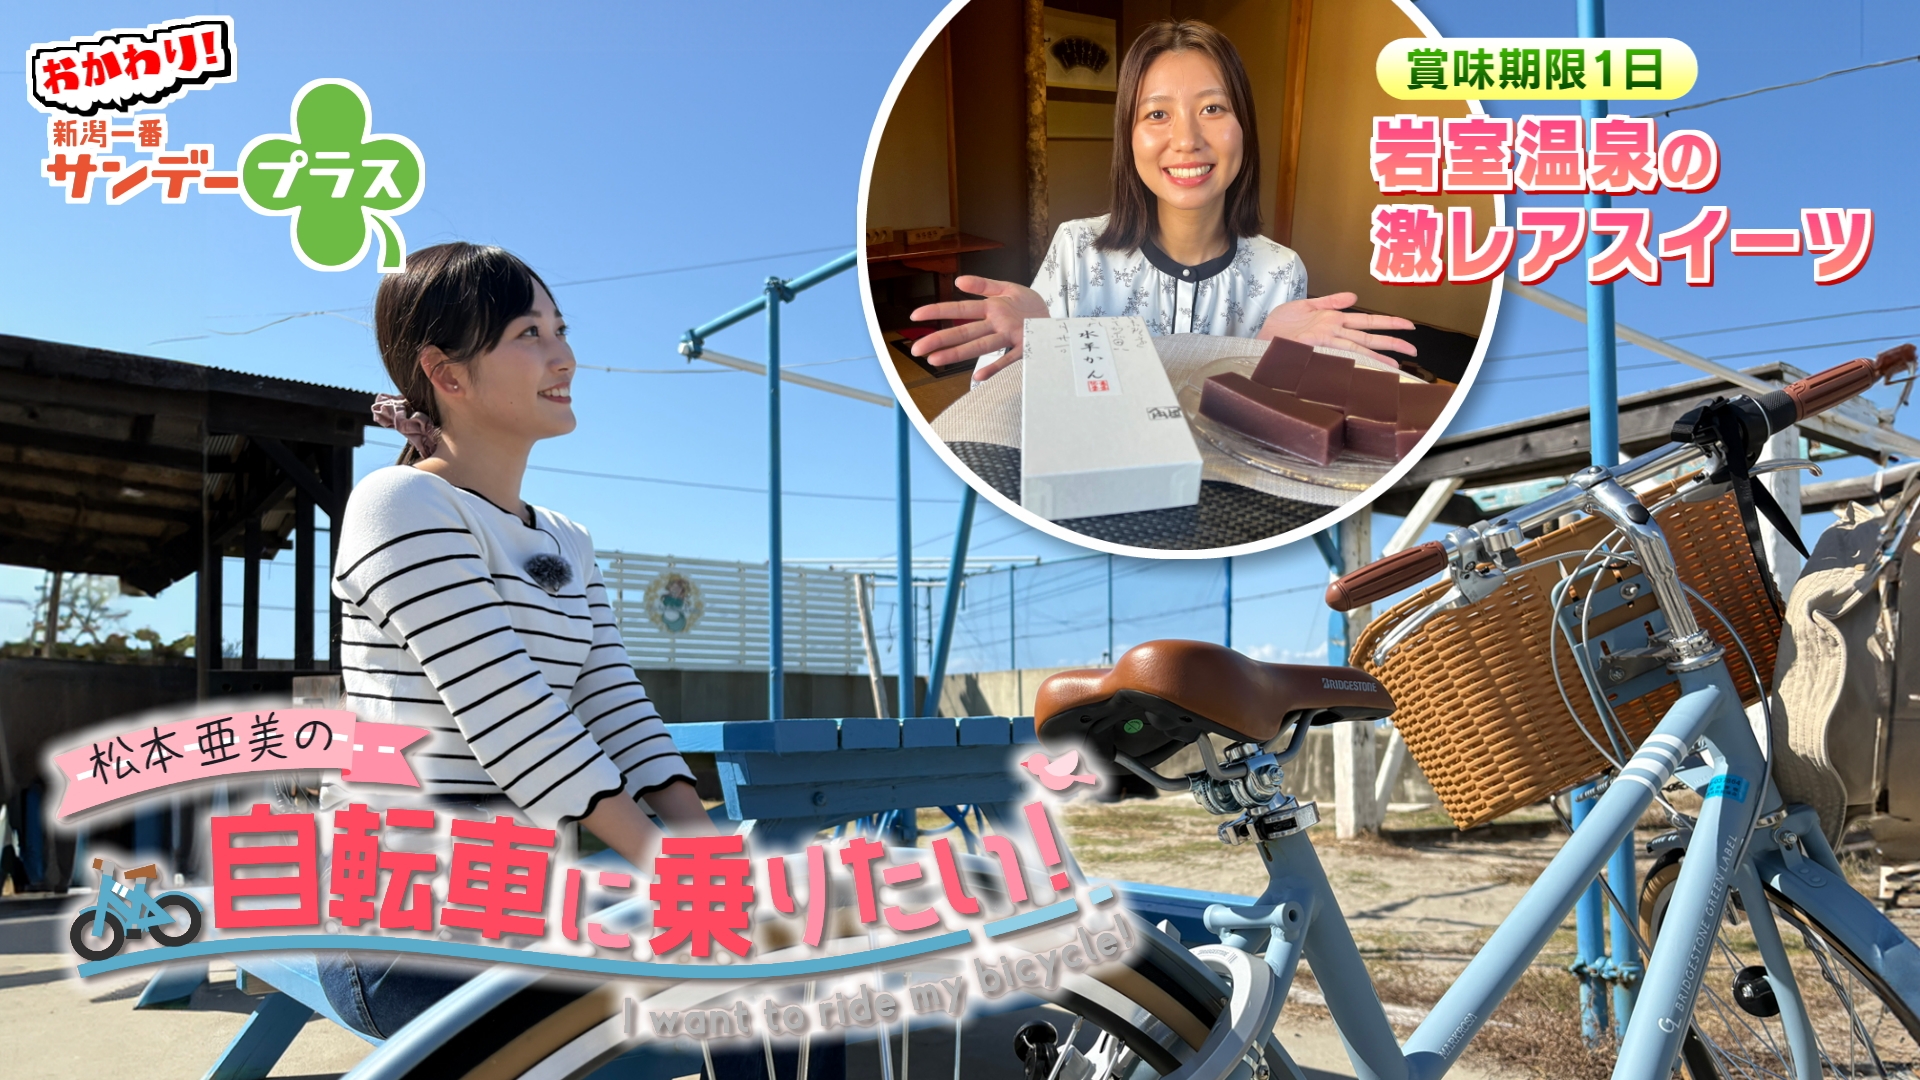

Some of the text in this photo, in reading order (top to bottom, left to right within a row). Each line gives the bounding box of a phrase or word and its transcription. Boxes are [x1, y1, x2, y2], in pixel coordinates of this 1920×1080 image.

[1321, 678, 1378, 692] BRIDGESTONE
[1675, 919, 1710, 1012] BRIDGESTONE
[1705, 872, 1725, 916] GREEN
[1719, 835, 1738, 873] LABEL
[1438, 1013, 1477, 1059] MARKROSA
